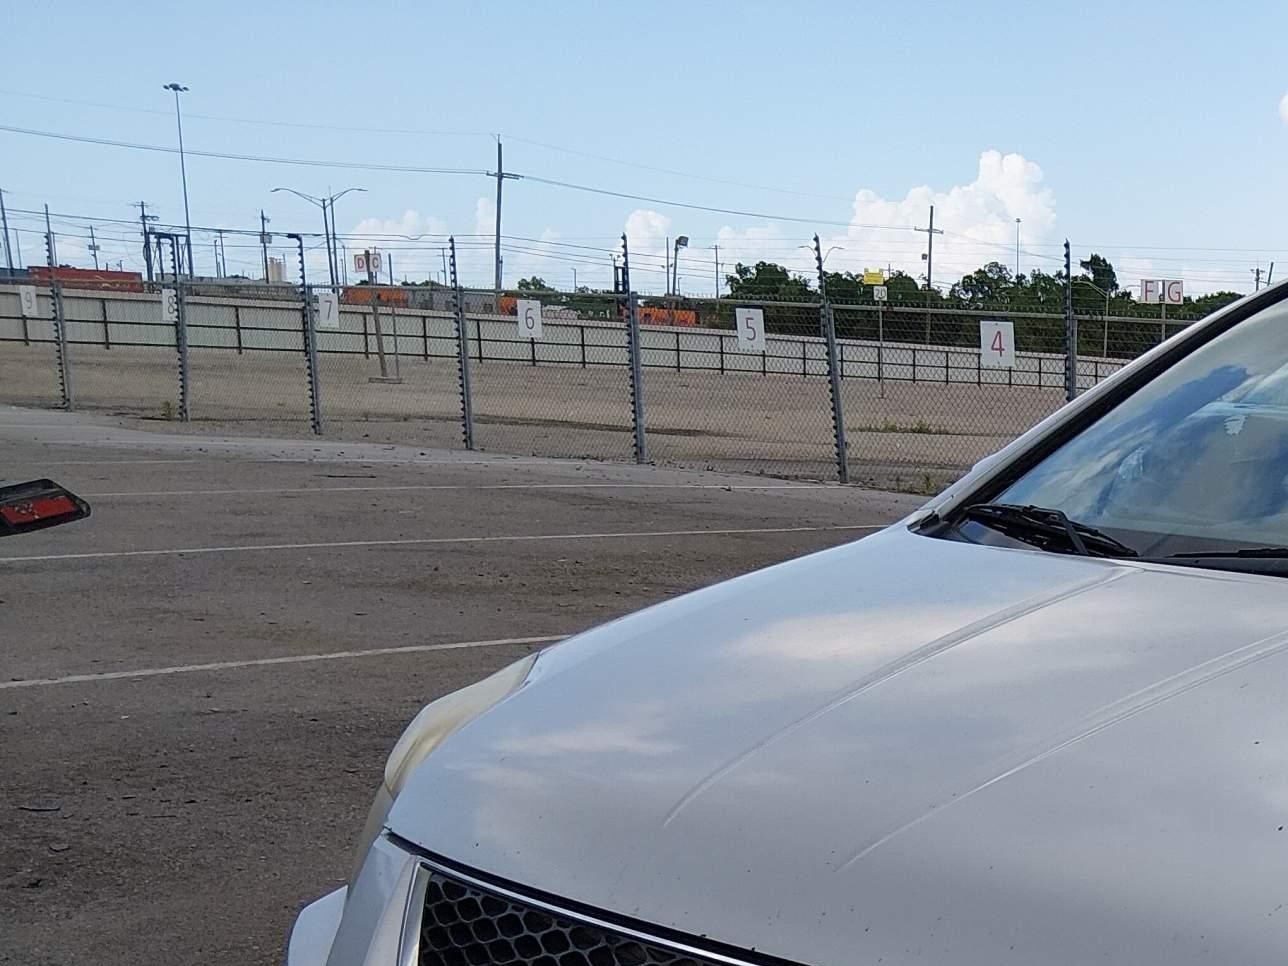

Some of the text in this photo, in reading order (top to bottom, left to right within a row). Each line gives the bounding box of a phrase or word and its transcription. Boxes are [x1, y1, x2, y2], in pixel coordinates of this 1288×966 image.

[357, 257, 365, 270] D
[372, 256, 380, 269] C
[25, 289, 33, 309] 9
[1144, 280, 1154, 302] F
[1167, 281, 1182, 302] G
[167, 295, 175, 314] 8
[324, 299, 333, 320] 7
[524, 307, 535, 330] 6
[745, 317, 757, 341] 5
[990, 330, 1005, 357] 4
